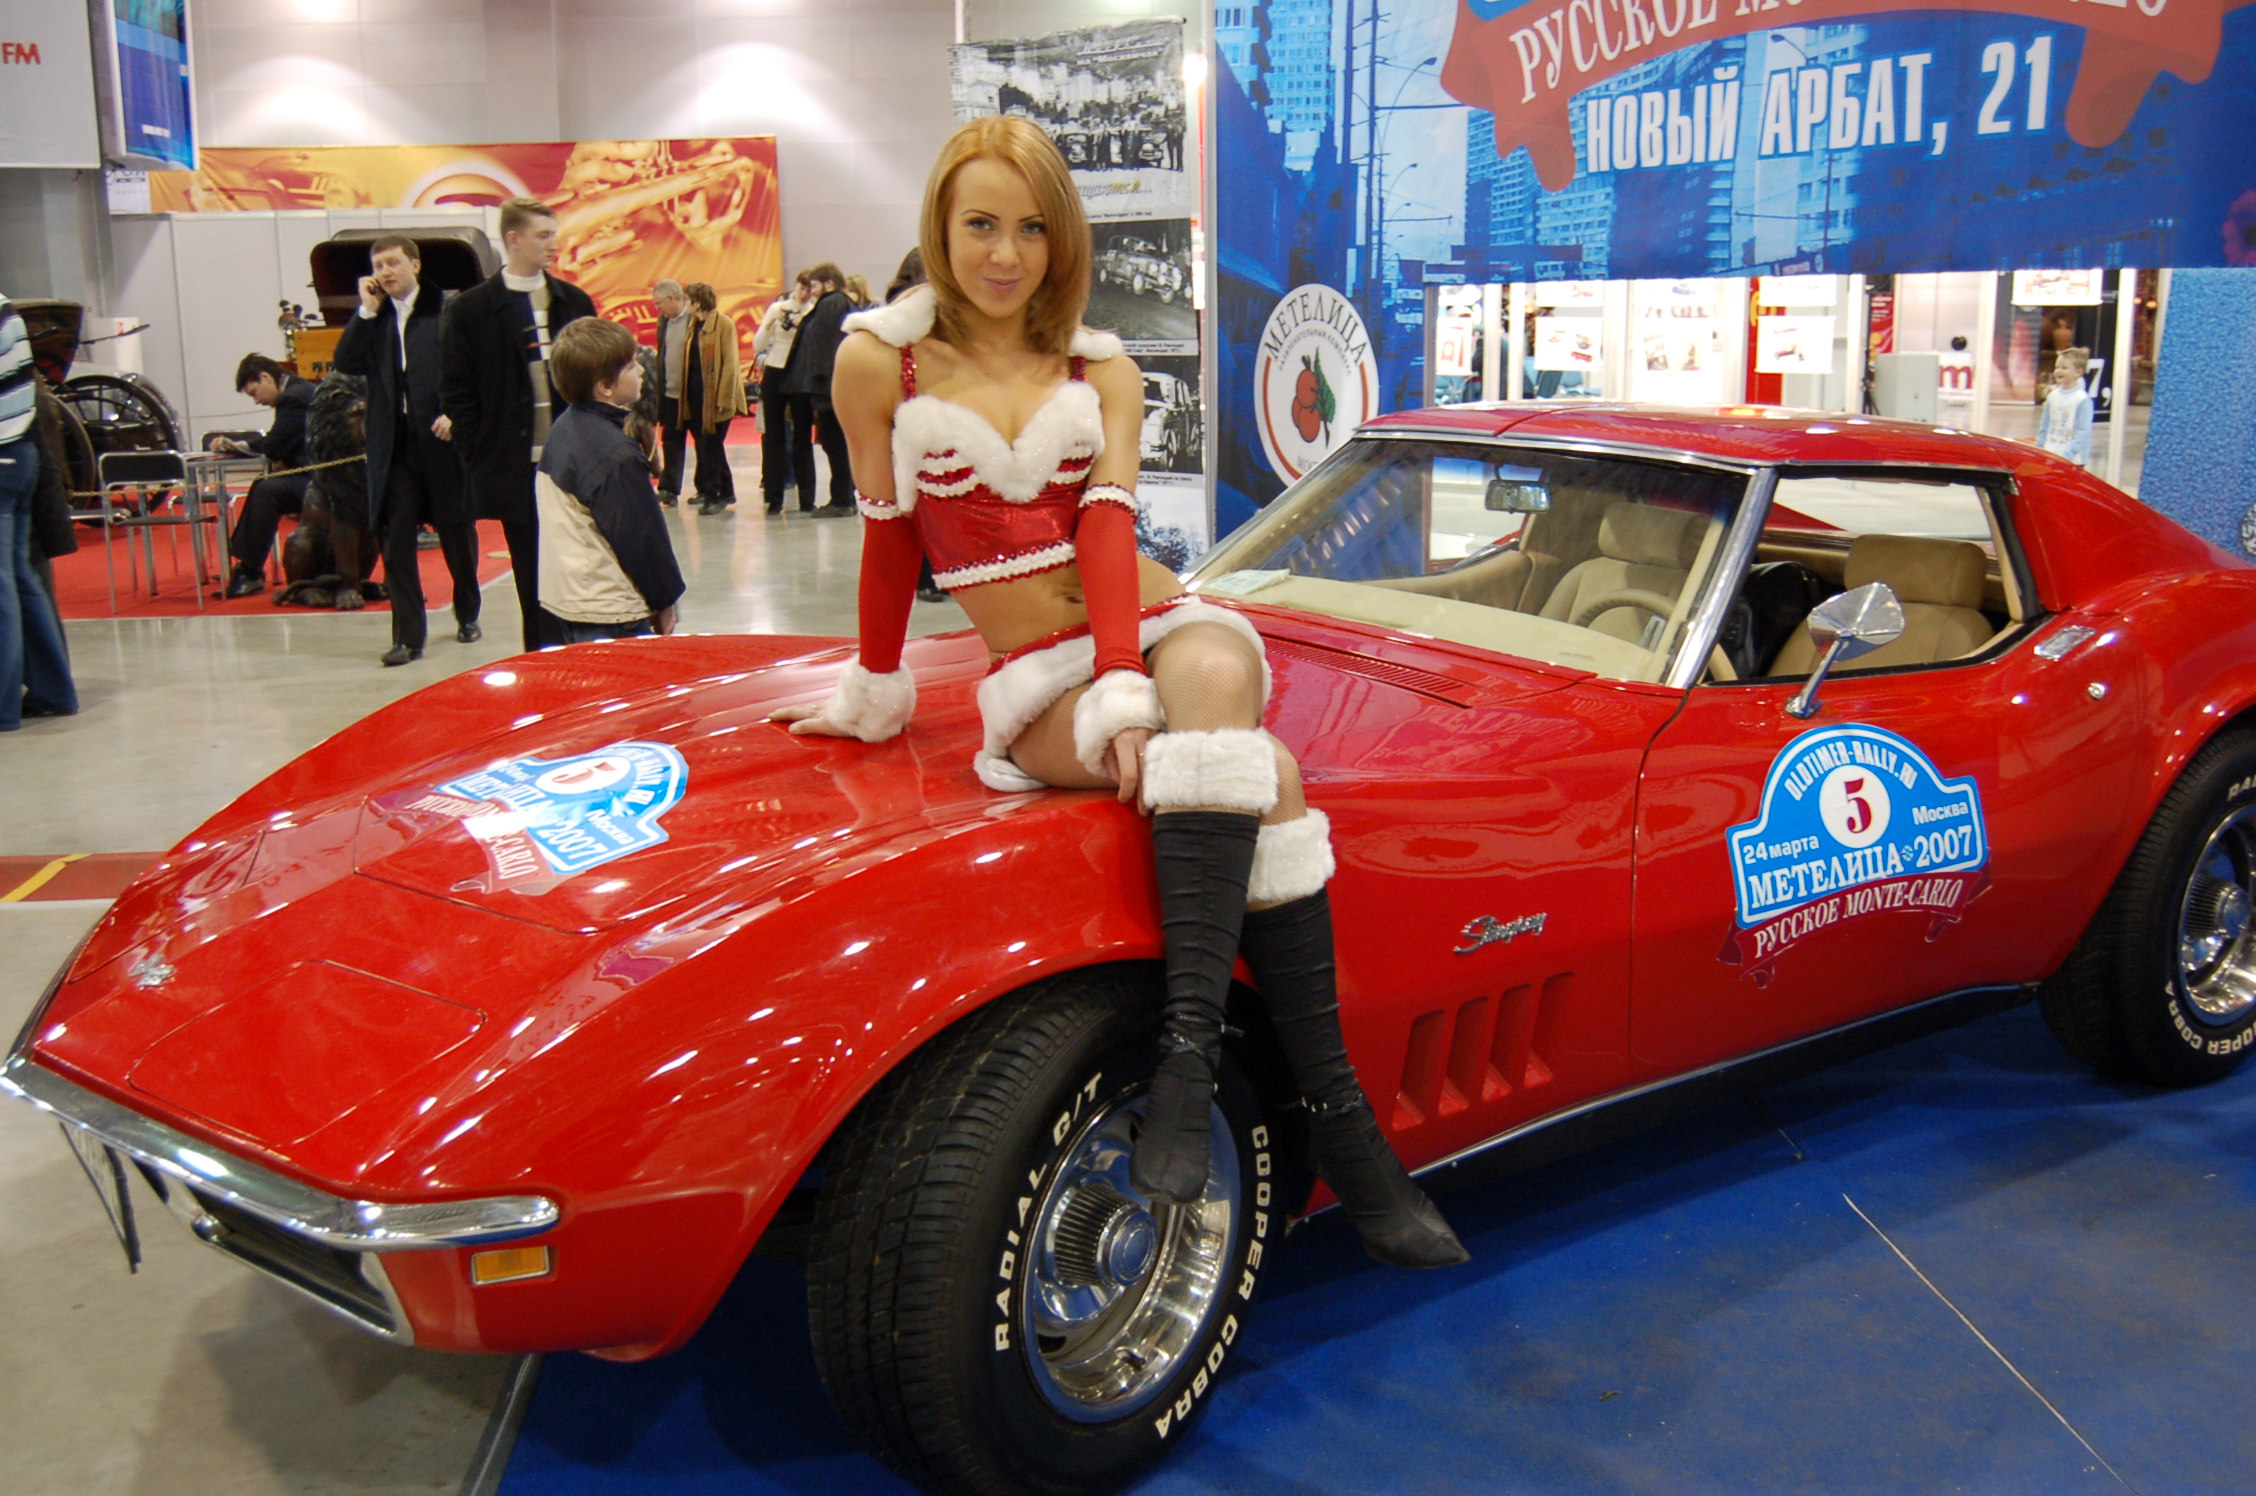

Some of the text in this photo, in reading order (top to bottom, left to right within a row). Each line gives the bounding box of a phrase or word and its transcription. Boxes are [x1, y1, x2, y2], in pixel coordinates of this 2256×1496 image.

[2, 42, 41, 65] FM
[1587, 35, 2052, 173] НОВЫЙ АРБАТ, 21
[1264, 291, 1367, 362] МЕТЕЛИЦА
[551, 761, 618, 785] 5
[1784, 740, 1918, 801] OLDTIMER-RALLY.RU
[585, 808, 635, 846] Москва
[1844, 777, 1872, 834] 5
[1912, 801, 1969, 825] Москва
[537, 820, 609, 860] 2007
[1743, 842, 1768, 864] 24
[1748, 825, 1972, 908] МЕТЕЛИЦА 2007
[1754, 878, 1964, 958] РУССКОЕ MONTE-CARLO
[2165, 980, 2203, 1050] COBRA
[995, 1072, 1102, 1351] RADIAL G/T
[1155, 1125, 1271, 1439] COOPER COBRA
